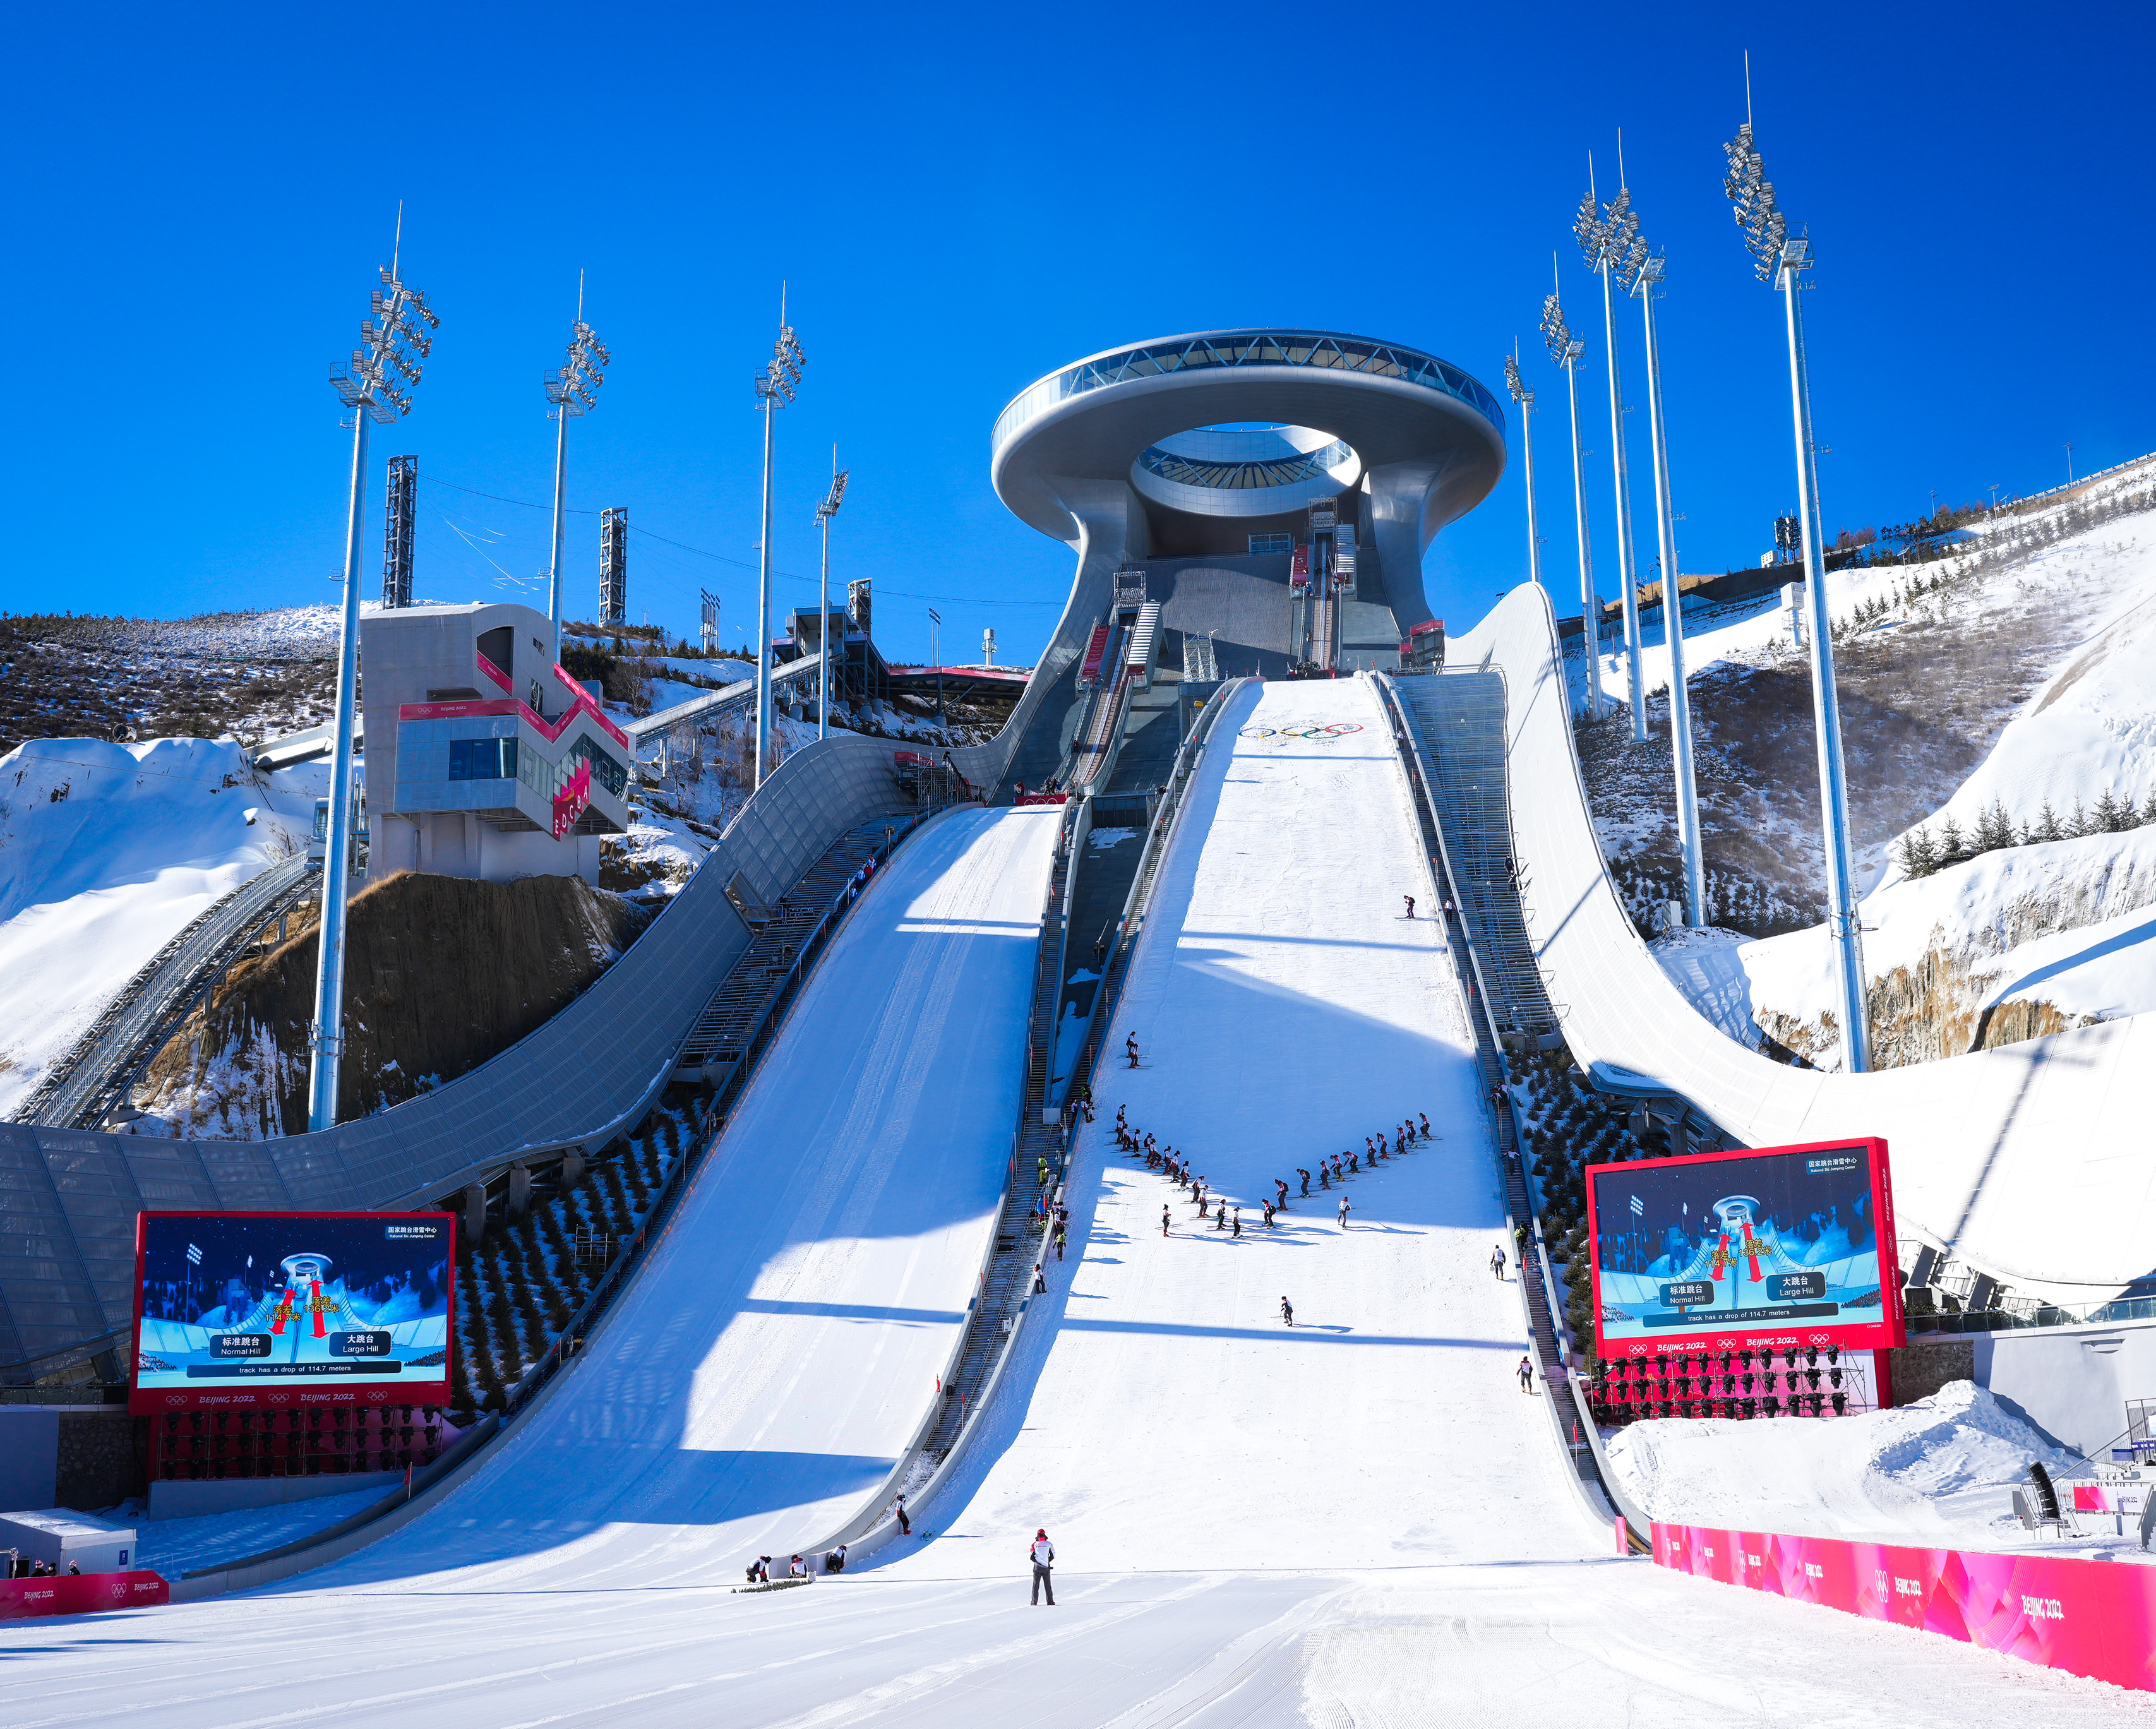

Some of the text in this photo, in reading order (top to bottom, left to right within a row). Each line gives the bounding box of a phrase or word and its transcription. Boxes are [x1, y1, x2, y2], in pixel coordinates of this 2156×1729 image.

[555, 785, 588, 834] E D C B A
[1809, 1157, 1857, 1168] 国家跳台滑雪中心
[1745, 1238, 1763, 1248] 落差
[1711, 1250, 1728, 1260] 落差
[1739, 1245, 1772, 1257] 136.2米
[1704, 1257, 1738, 1268] 114.7米
[1783, 1276, 1809, 1286] 大跳台
[1670, 1284, 1703, 1295] 标准跳台
[1780, 1288, 1801, 1296] Large
[312, 1296, 331, 1305] 落差
[1670, 1296, 1693, 1304] Normal
[273, 1305, 292, 1313] 落差
[303, 1303, 339, 1313] 136.2米
[265, 1313, 301, 1322] 114.7米
[222, 1337, 260, 1346] 标准跳台
[347, 1334, 374, 1344] 大跳台
[1746, 1337, 1773, 1347] BEIJING
[343, 1346, 364, 1355] Large
[1656, 1343, 1684, 1351] BEIJING
[199, 1396, 230, 1405] BEIJING
[301, 1394, 331, 1403] BEIJING
[135, 1583, 148, 1593] BEIJING
[1895, 1576, 1922, 1598] BEIJING 2022
[24, 1591, 41, 1601] BEIJING
[2021, 1594, 2065, 1622] BEIJING 2022
